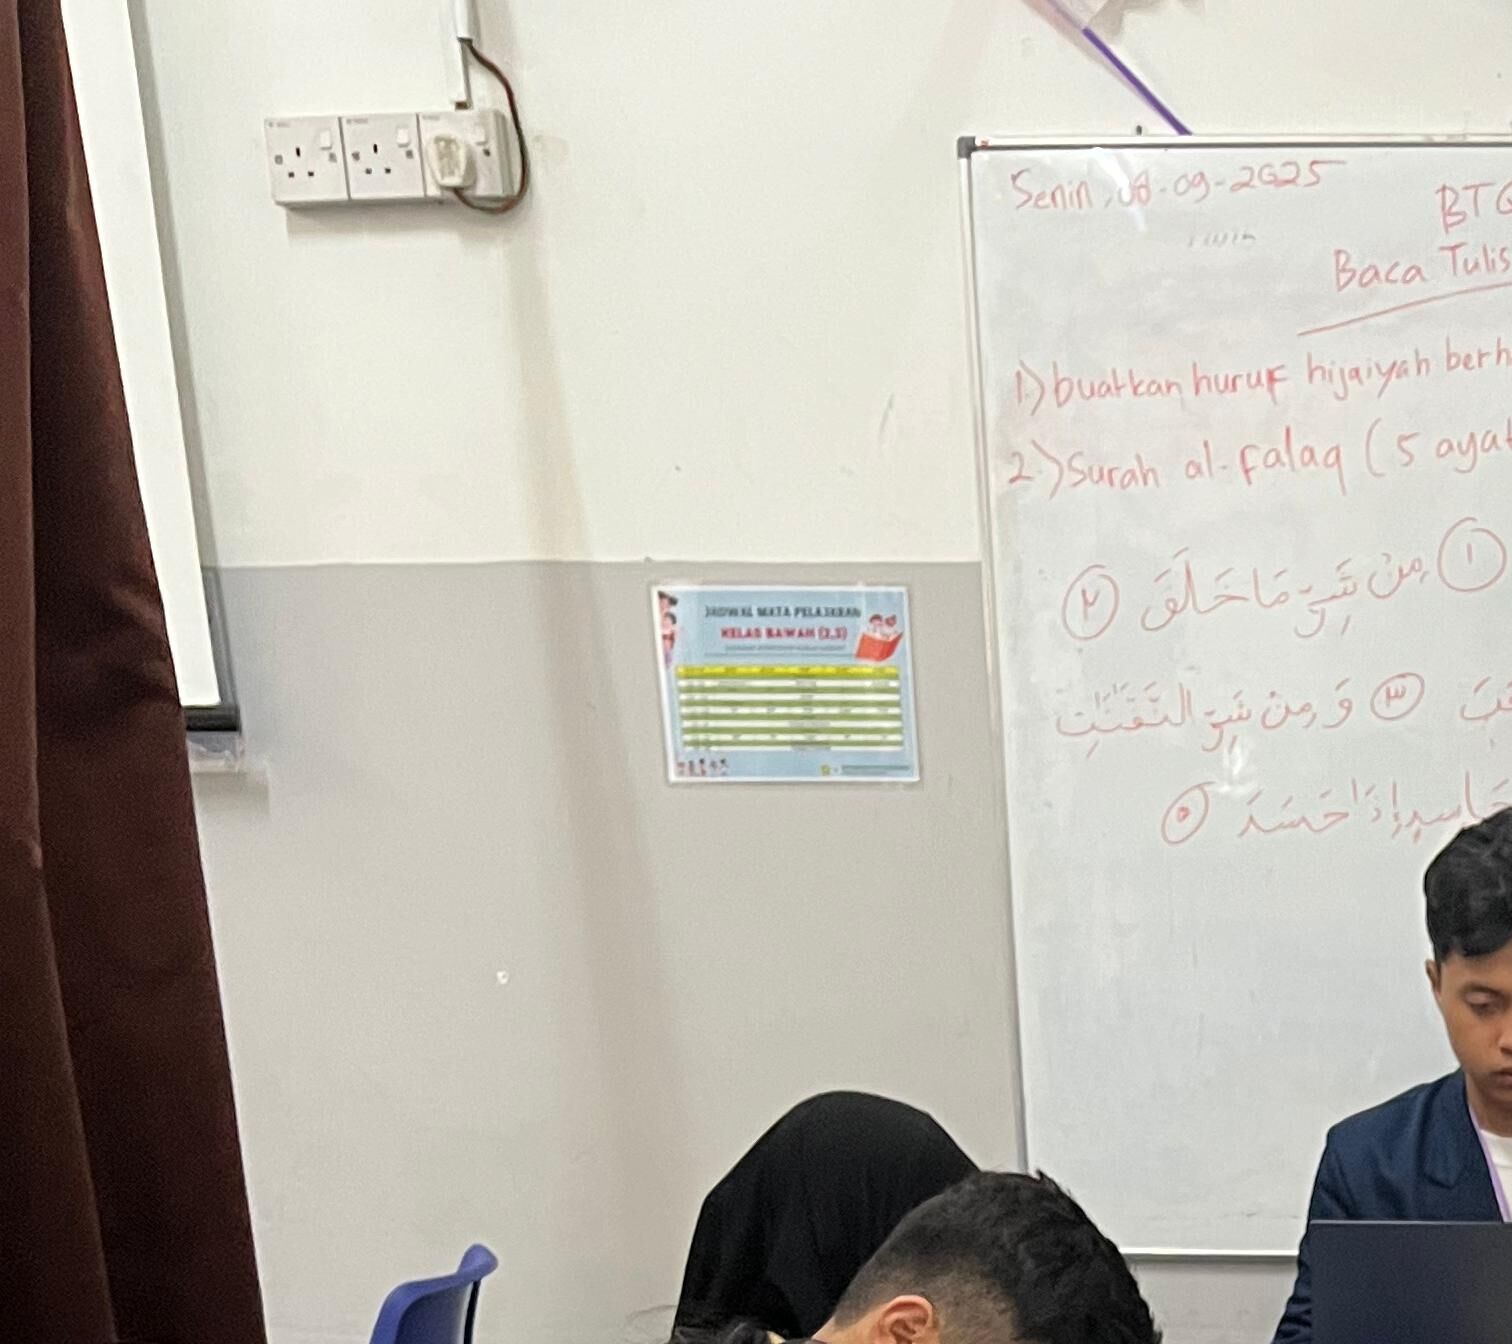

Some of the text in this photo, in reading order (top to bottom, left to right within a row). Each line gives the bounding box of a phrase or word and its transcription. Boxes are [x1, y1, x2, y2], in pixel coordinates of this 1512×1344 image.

[1333, 247, 1427, 292] Baca
[1439, 241, 1510, 277] Tulis
[1192, 361, 1288, 405] huruf
[756, 605, 792, 617] MATA
[720, 627, 762, 639] KELAS
[765, 627, 815, 639] BAWAH
